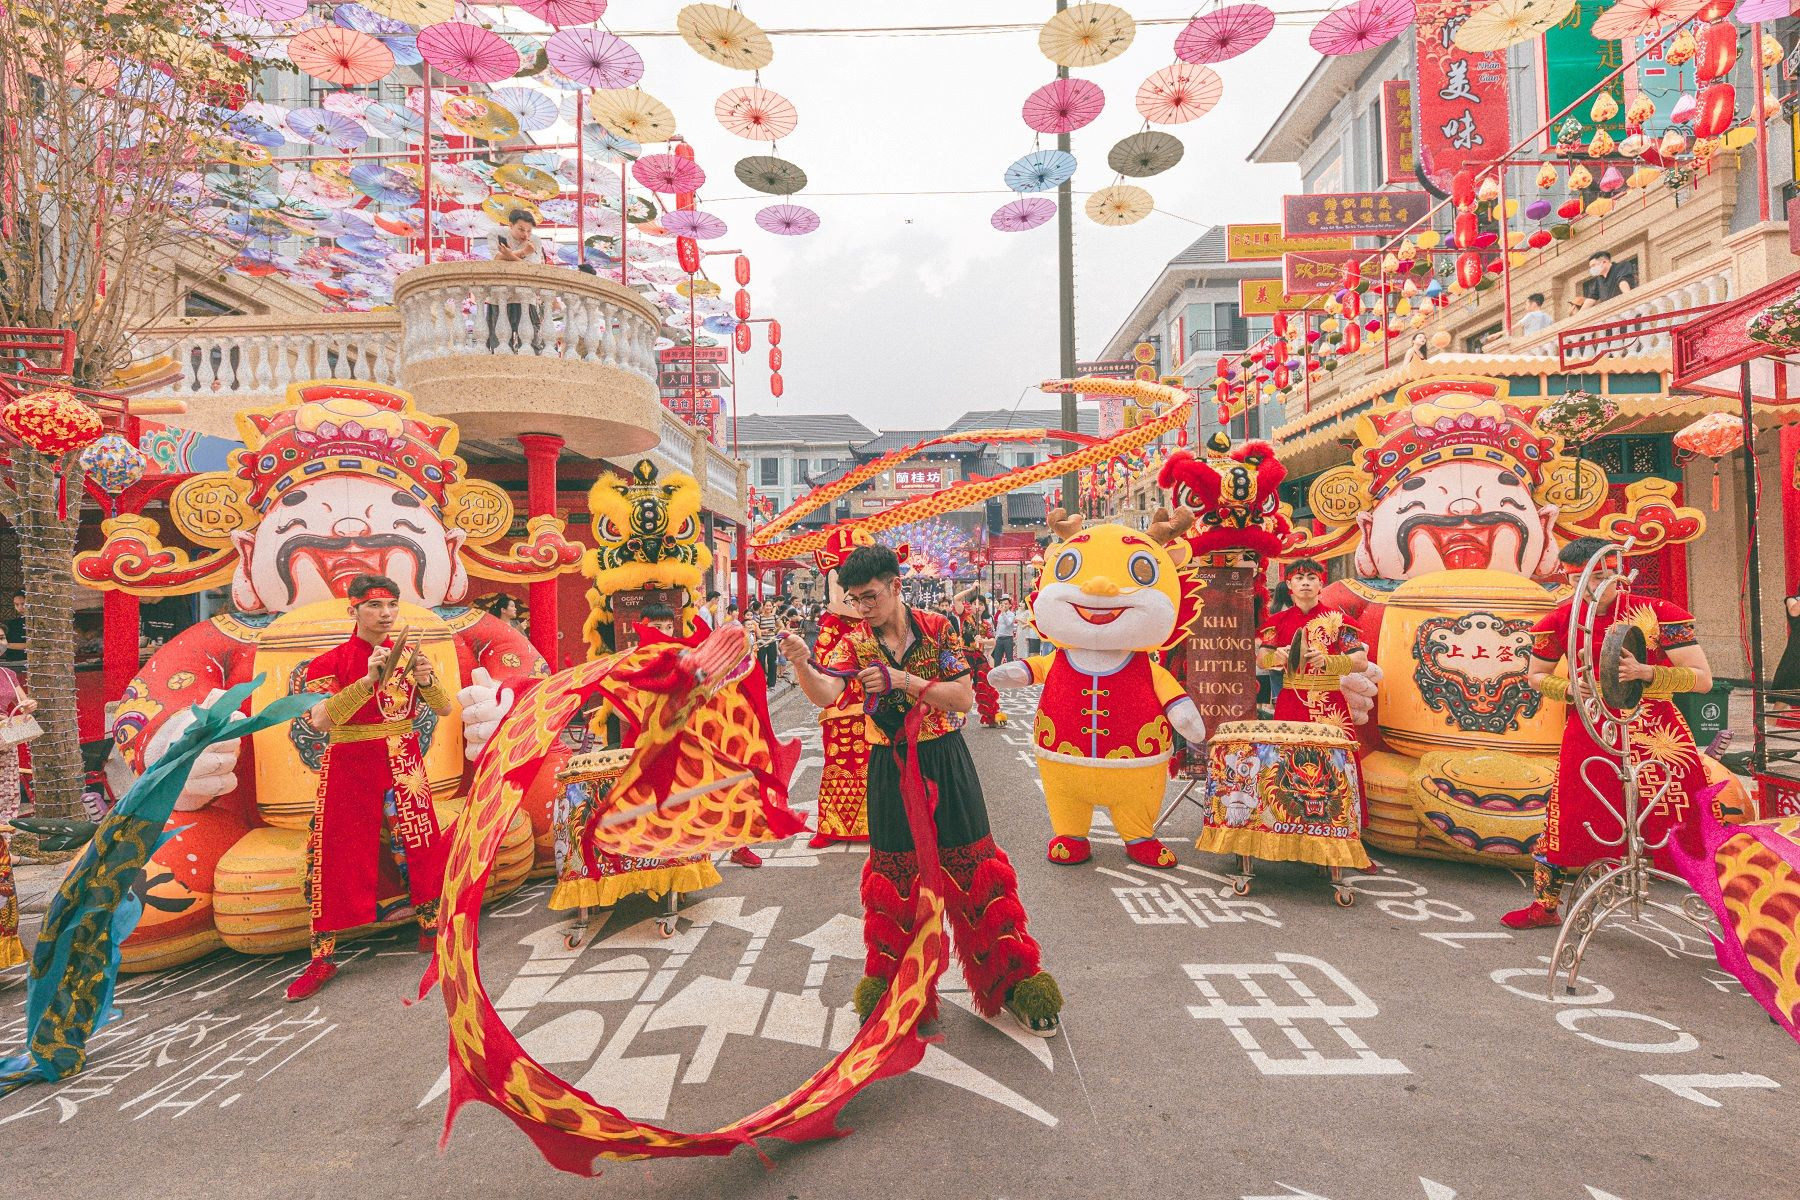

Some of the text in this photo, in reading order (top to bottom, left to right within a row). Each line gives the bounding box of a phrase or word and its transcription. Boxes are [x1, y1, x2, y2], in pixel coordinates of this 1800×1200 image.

[1294, 262, 1381, 279] 欢迎到
[895, 472, 941, 484] 蘭桂坊
[1203, 616, 1238, 628] KHAI
[1446, 644, 1514, 663] 上上签
[1195, 660, 1247, 672] LITTLE
[1199, 682, 1243, 694] HONG
[1200, 704, 1244, 716] KONG
[1274, 822, 1304, 834] 0972
[1307, 824, 1330, 836] 263
